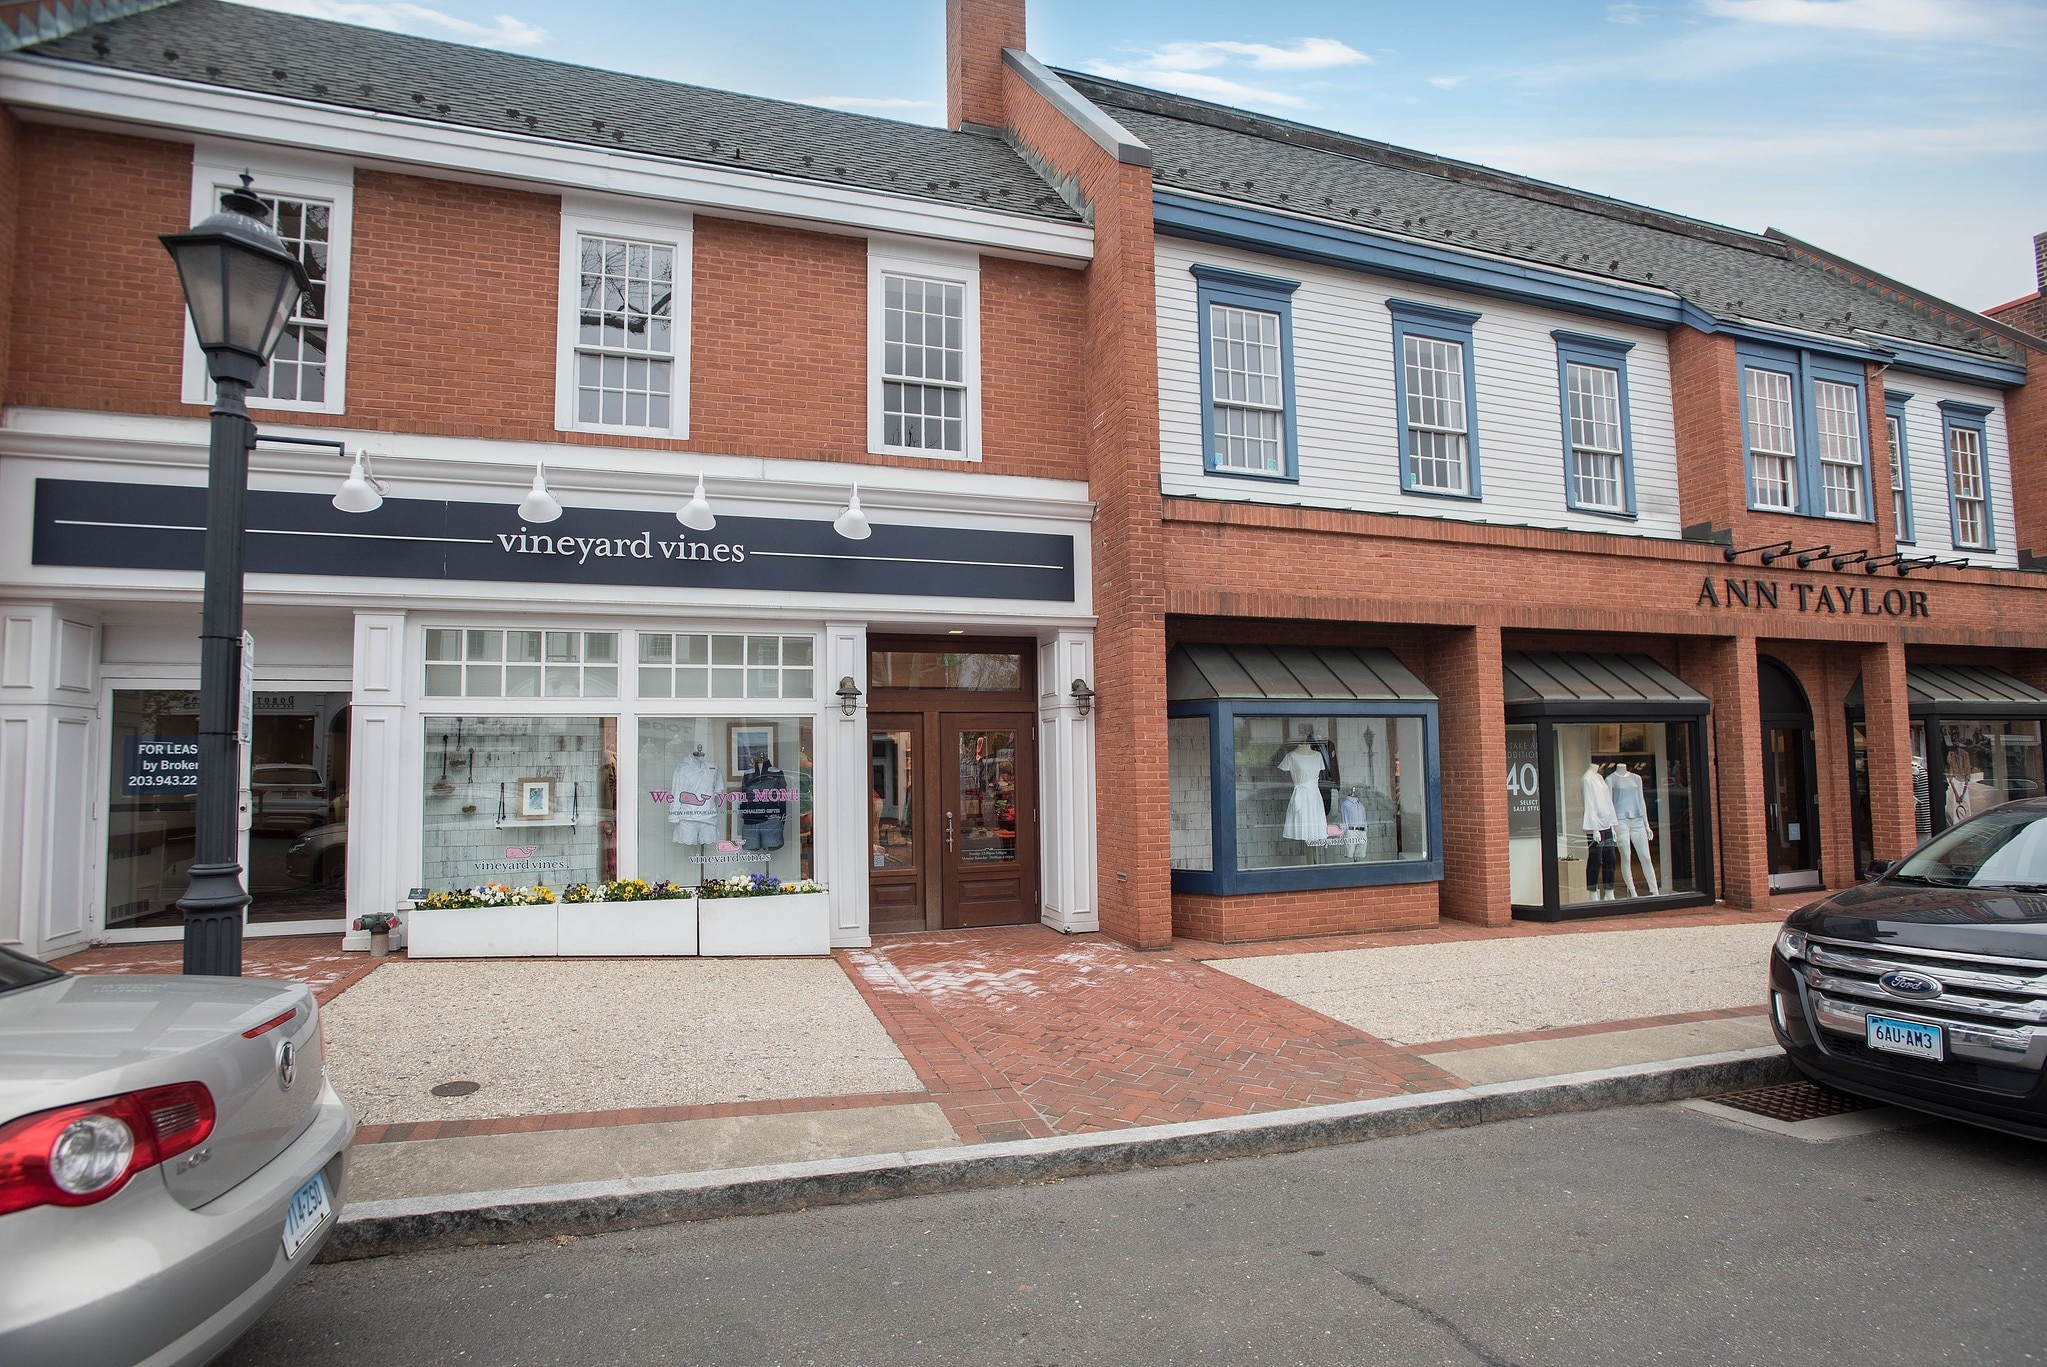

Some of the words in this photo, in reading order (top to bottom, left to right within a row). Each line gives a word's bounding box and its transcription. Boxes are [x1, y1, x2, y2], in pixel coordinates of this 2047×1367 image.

[497, 526, 653, 565] vineyard
[657, 534, 745, 563] vines
[1696, 576, 1779, 609] ANN
[1790, 582, 1930, 618] TAYLOR
[138, 744, 164, 755] FOR
[166, 744, 198, 755] LEAS
[1509, 742, 1528, 750] TAKE
[142, 760, 158, 772] by
[128, 775, 197, 787] 203.943.22
[649, 790, 675, 804] We
[717, 791, 748, 808] you
[752, 788, 800, 803] MOM!
[1527, 804, 1540, 812] STYL
[689, 853, 740, 865] vineyard
[741, 853, 772, 862] vines
[474, 859, 529, 873] vineyard
[531, 860, 565, 869] vines
[1891, 975, 1923, 991] Ford
